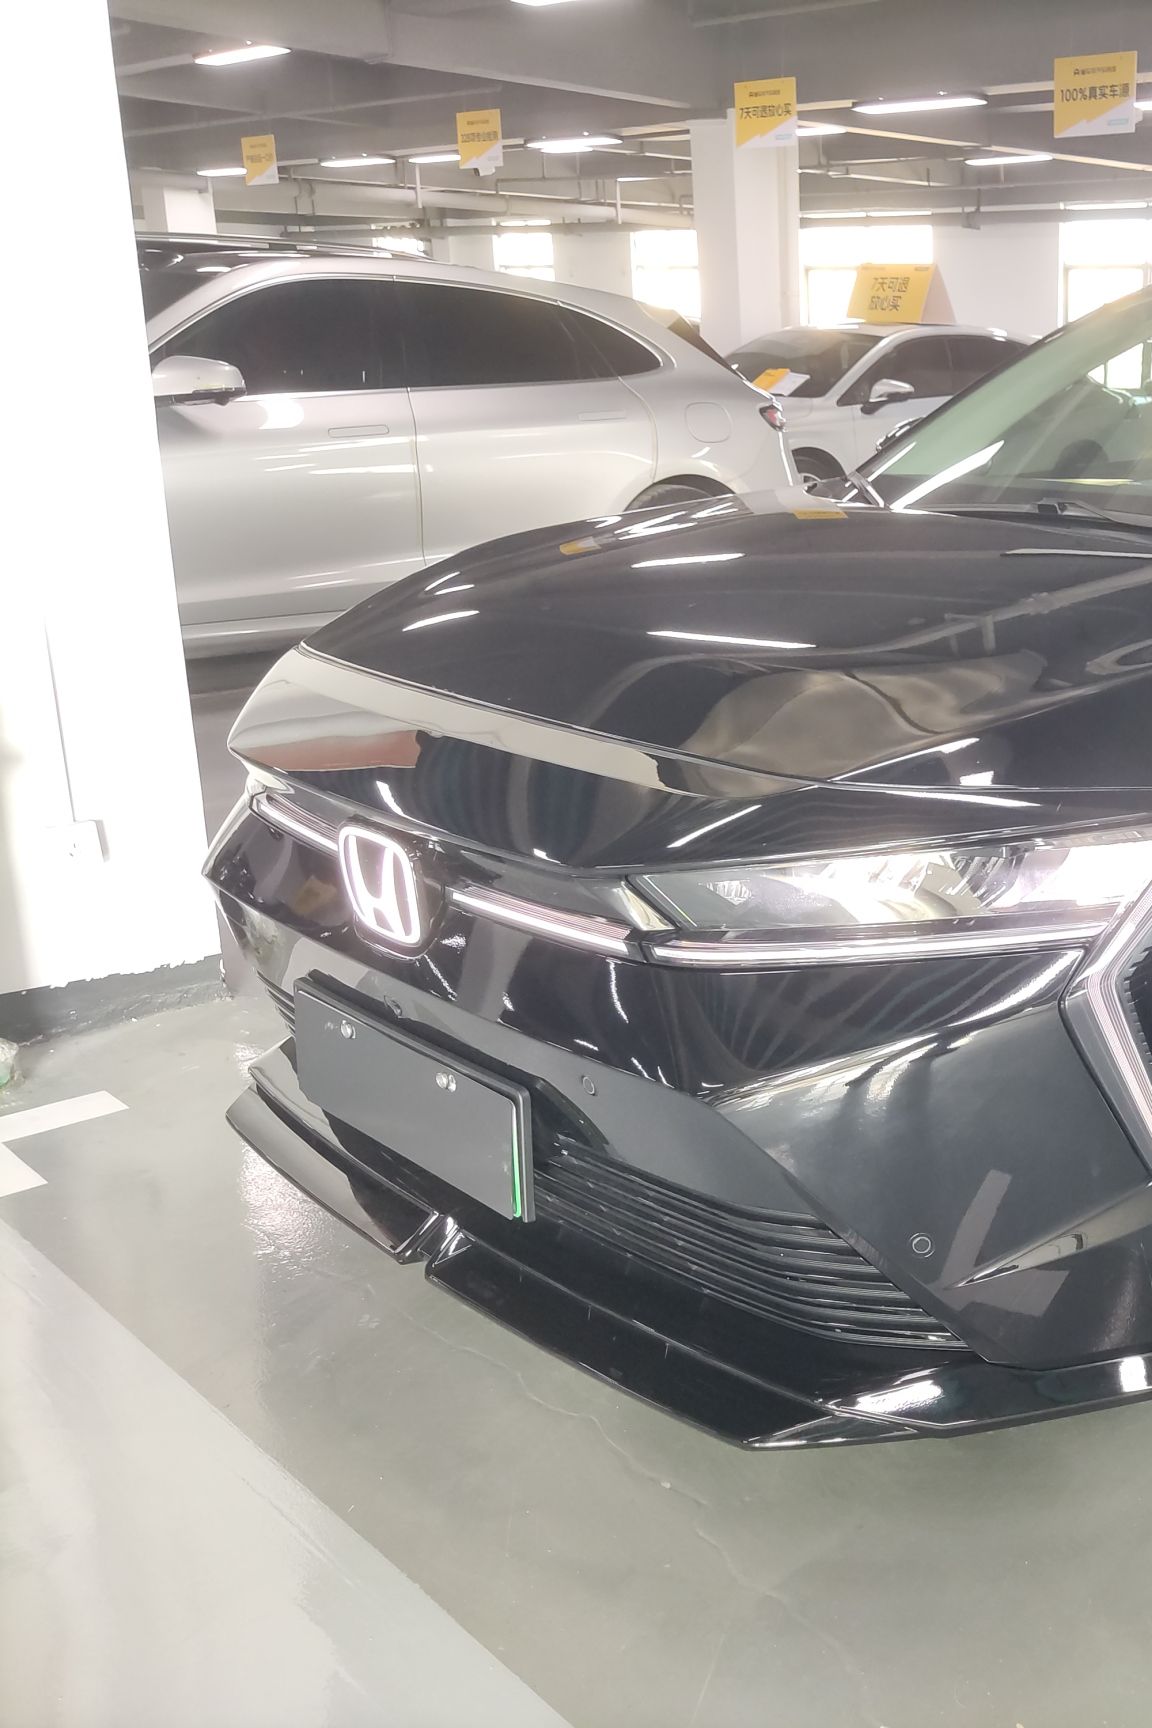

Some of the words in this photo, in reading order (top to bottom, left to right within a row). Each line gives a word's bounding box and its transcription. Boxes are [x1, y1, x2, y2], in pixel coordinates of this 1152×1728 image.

[1060, 83, 1130, 103] 100%真实车源
[739, 103, 792, 120] 7天可退放心买
[871, 276, 911, 293] 7天可退
[868, 295, 902, 312] 放心买
